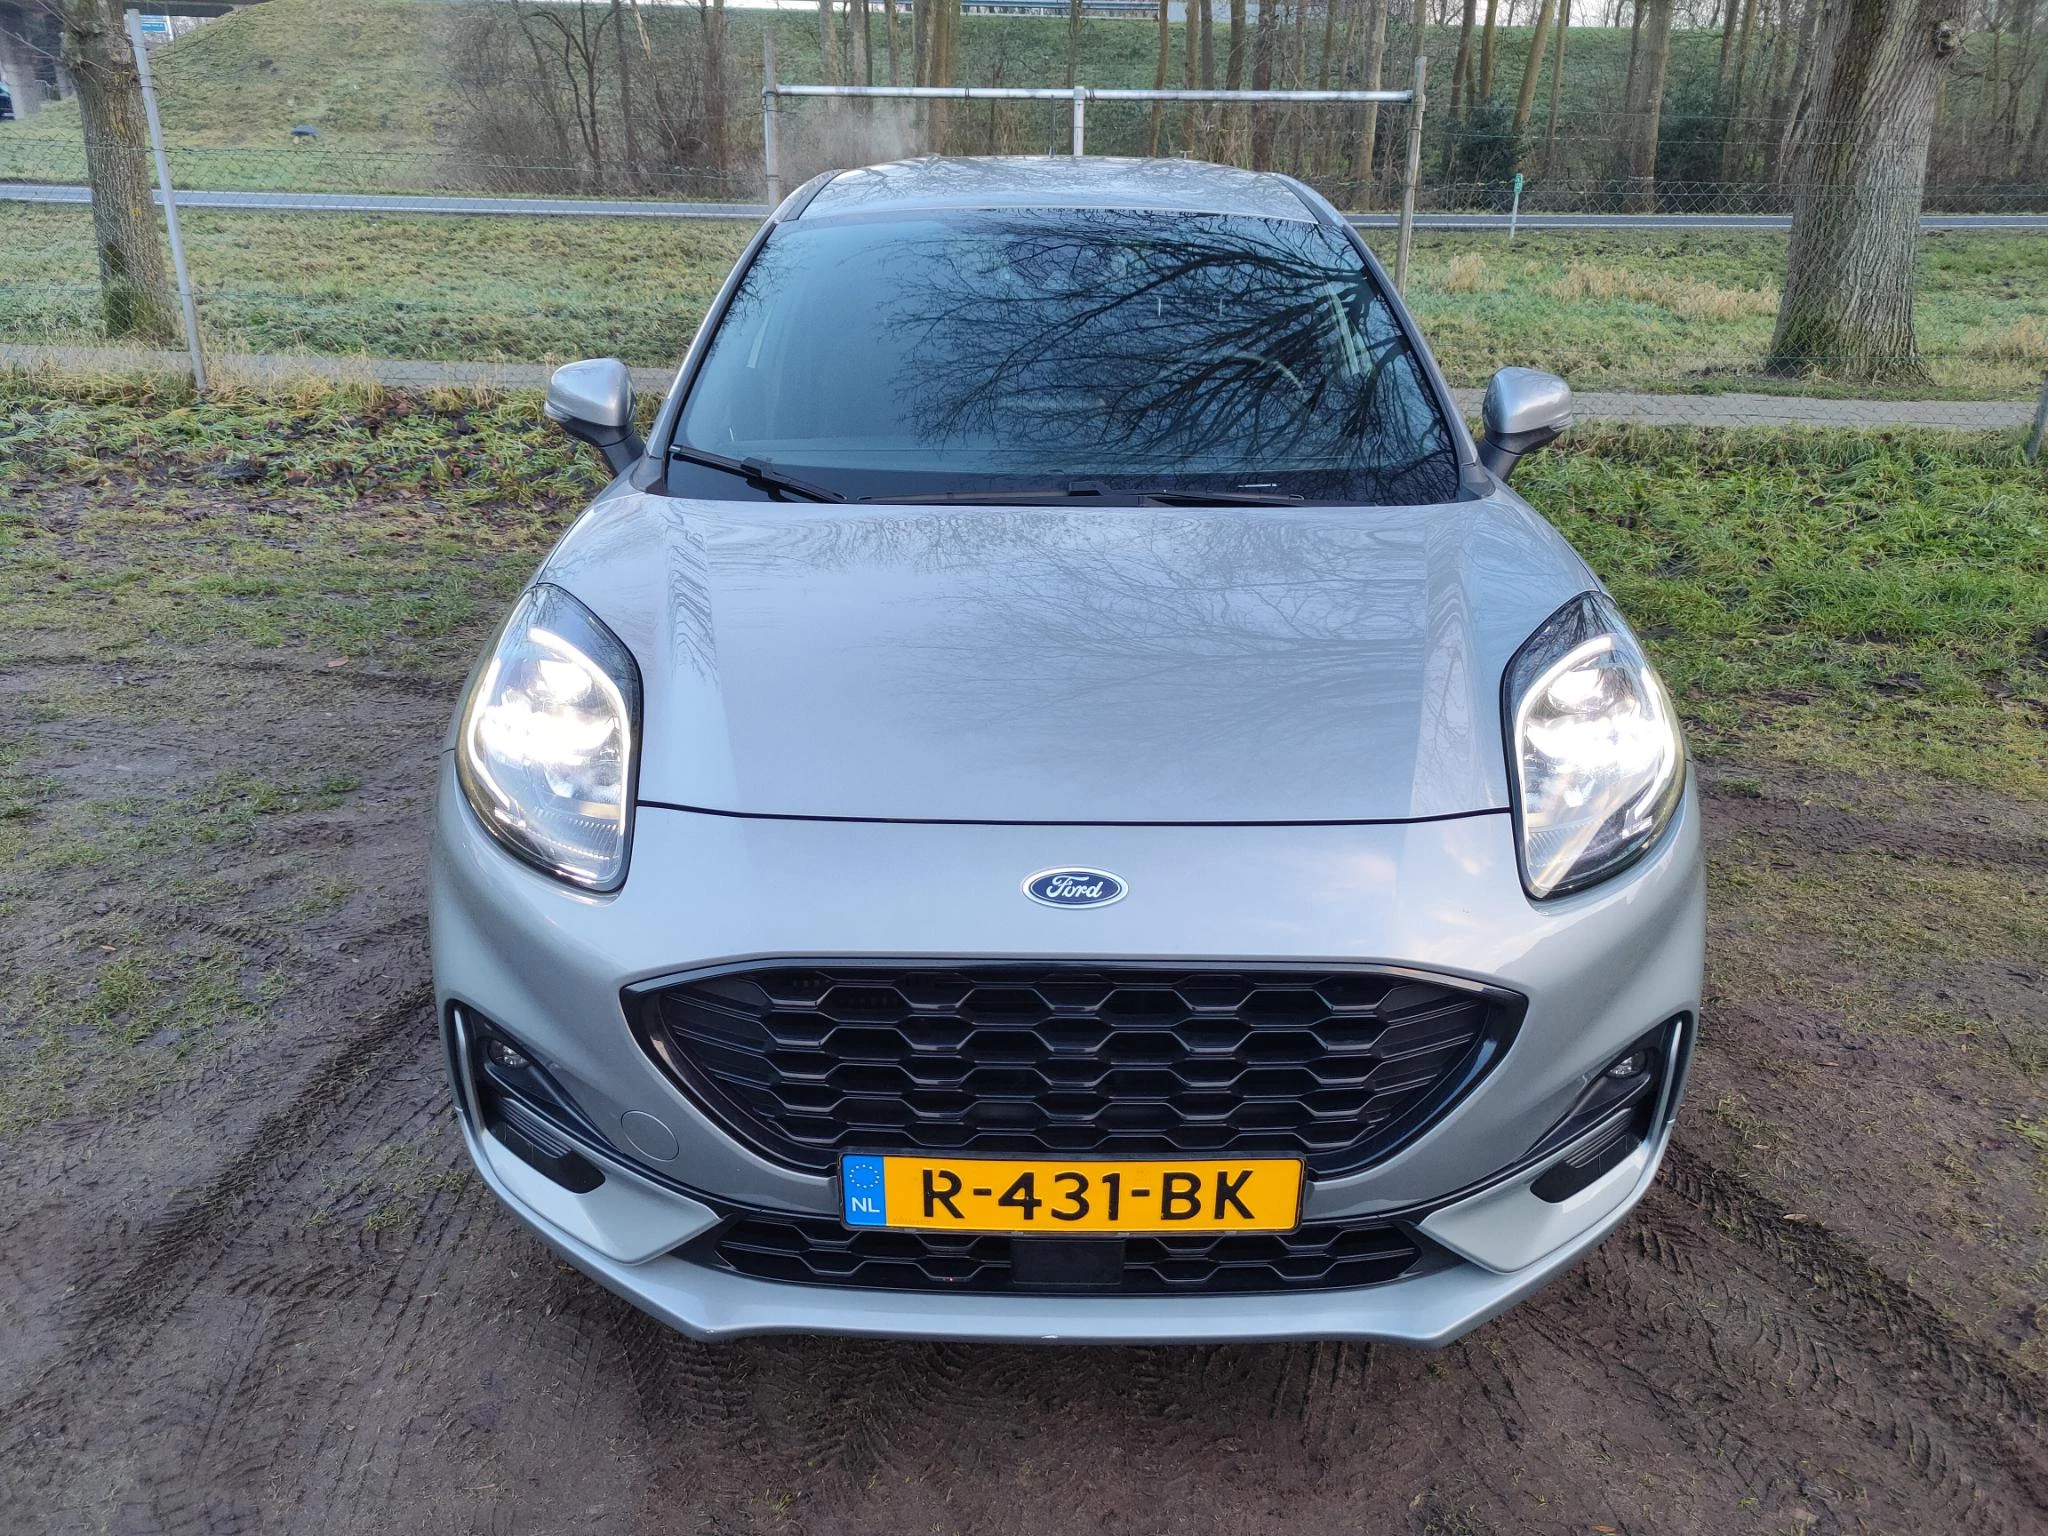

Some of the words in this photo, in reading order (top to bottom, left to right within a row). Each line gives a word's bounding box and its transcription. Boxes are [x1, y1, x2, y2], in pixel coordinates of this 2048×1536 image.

[1046, 875, 1104, 898] Ford
[851, 1196, 881, 1213] NL
[922, 1168, 1256, 1221] R-431-BK
